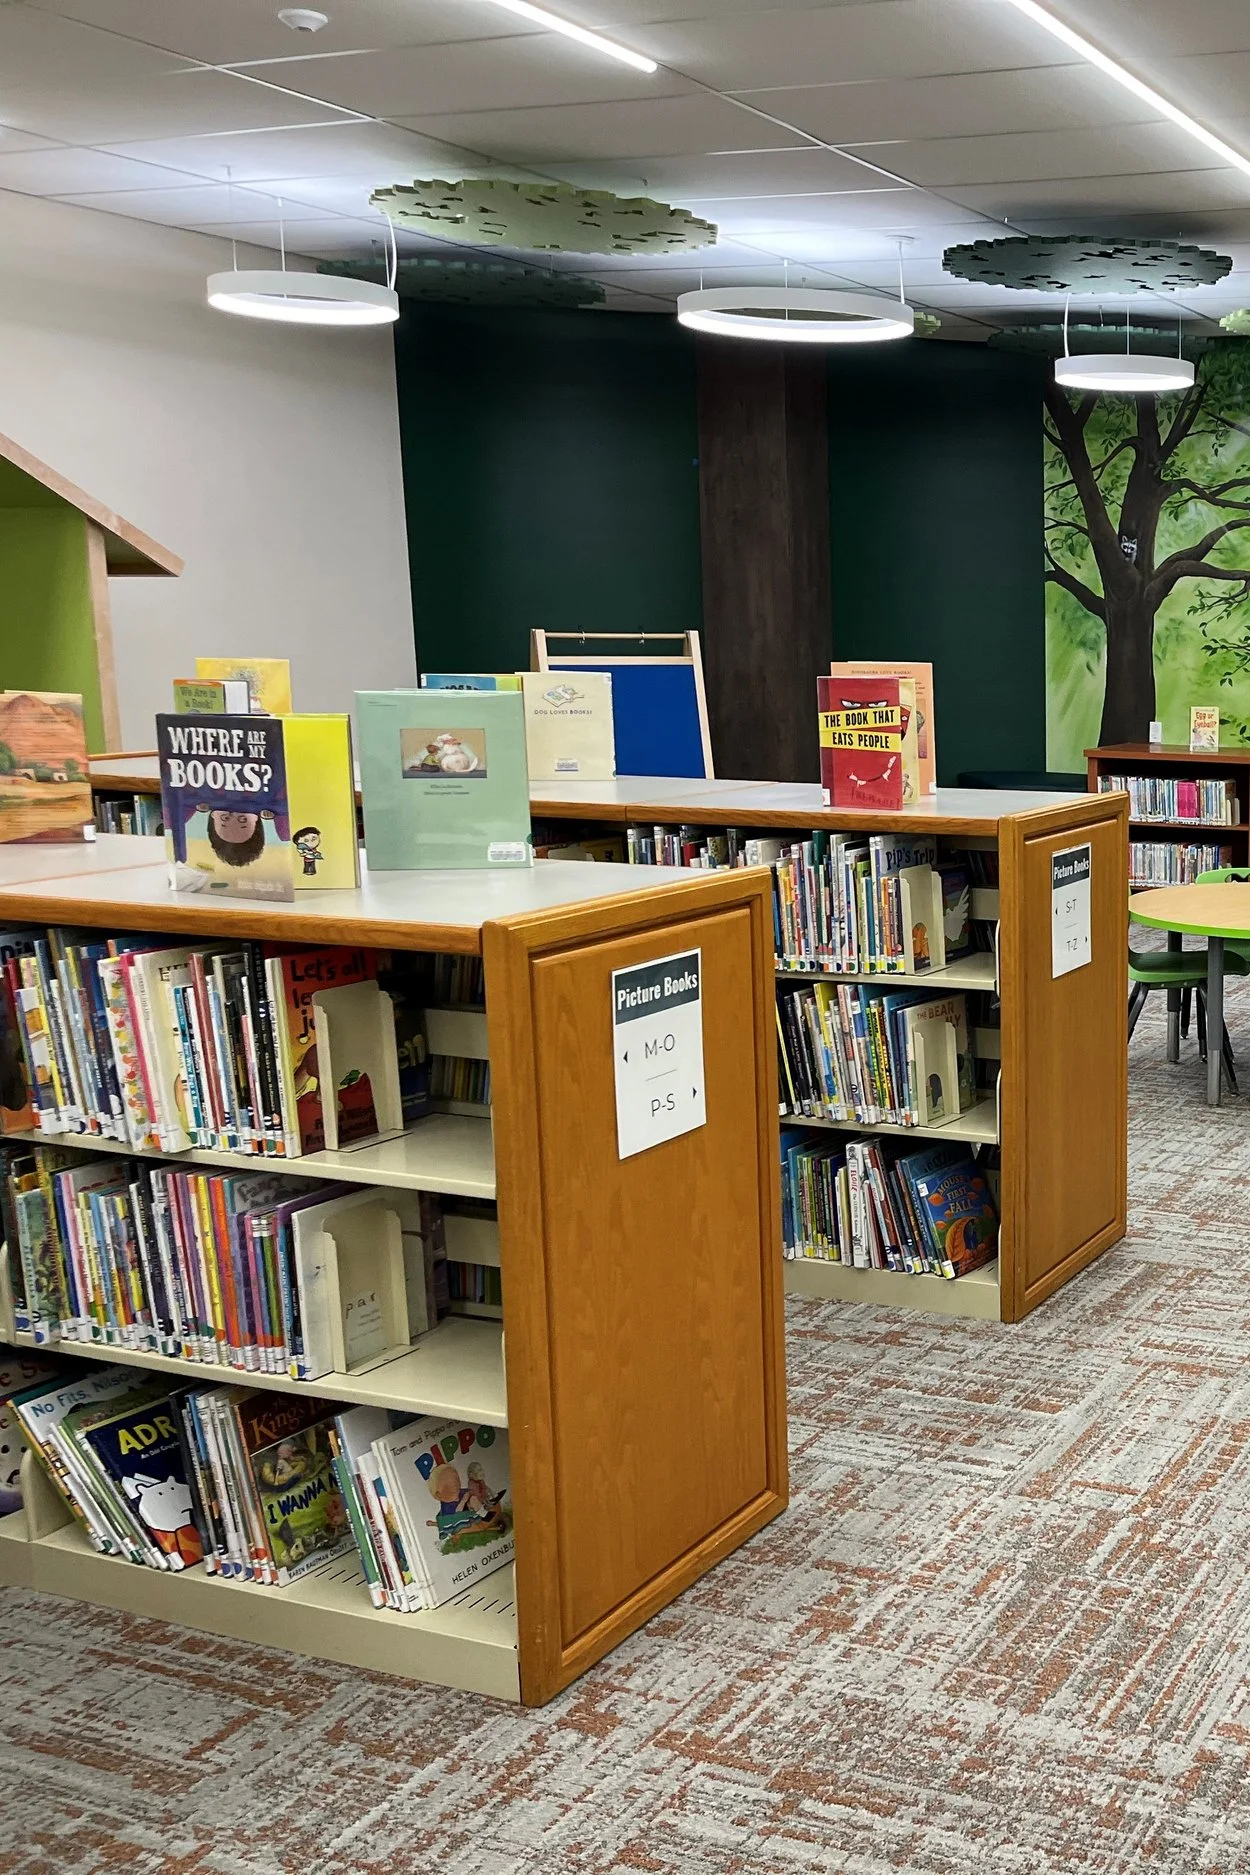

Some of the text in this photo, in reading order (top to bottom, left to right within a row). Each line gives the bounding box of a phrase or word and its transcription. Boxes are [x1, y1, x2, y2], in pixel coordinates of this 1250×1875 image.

[824, 709, 895, 728] THE BOOK THAT
[167, 726, 266, 758] WHERE ARE
[248, 745, 266, 759] MY
[832, 731, 890, 749] EATS PEOPLE
[167, 758, 273, 793] BOOKS?
[886, 846, 936, 870] Pip's Trip
[1054, 857, 1089, 880] Picture Books
[1066, 898, 1077, 914] S-T
[1066, 938, 1078, 952] T-Z
[291, 958, 336, 982] Let's
[617, 971, 698, 1011] Picture Books
[928, 1001, 954, 1019] BEAR
[644, 1033, 676, 1060] M-O
[650, 1093, 675, 1118] P-S
[947, 1186, 967, 1200] FIRST
[949, 1199, 972, 1213] FALL
[30, 1403, 54, 1417] No
[118, 1416, 177, 1455] ADR
[390, 1446, 407, 1456] Tom
[409, 1436, 423, 1448] and
[424, 1425, 445, 1438] Pippo
[415, 1425, 496, 1481] PIPPO
[268, 1504, 278, 1524] I
[277, 1478, 327, 1517] WANNA
[288, 1566, 305, 1579] KAREN
[452, 1541, 515, 1584] HELEN OXENBU
